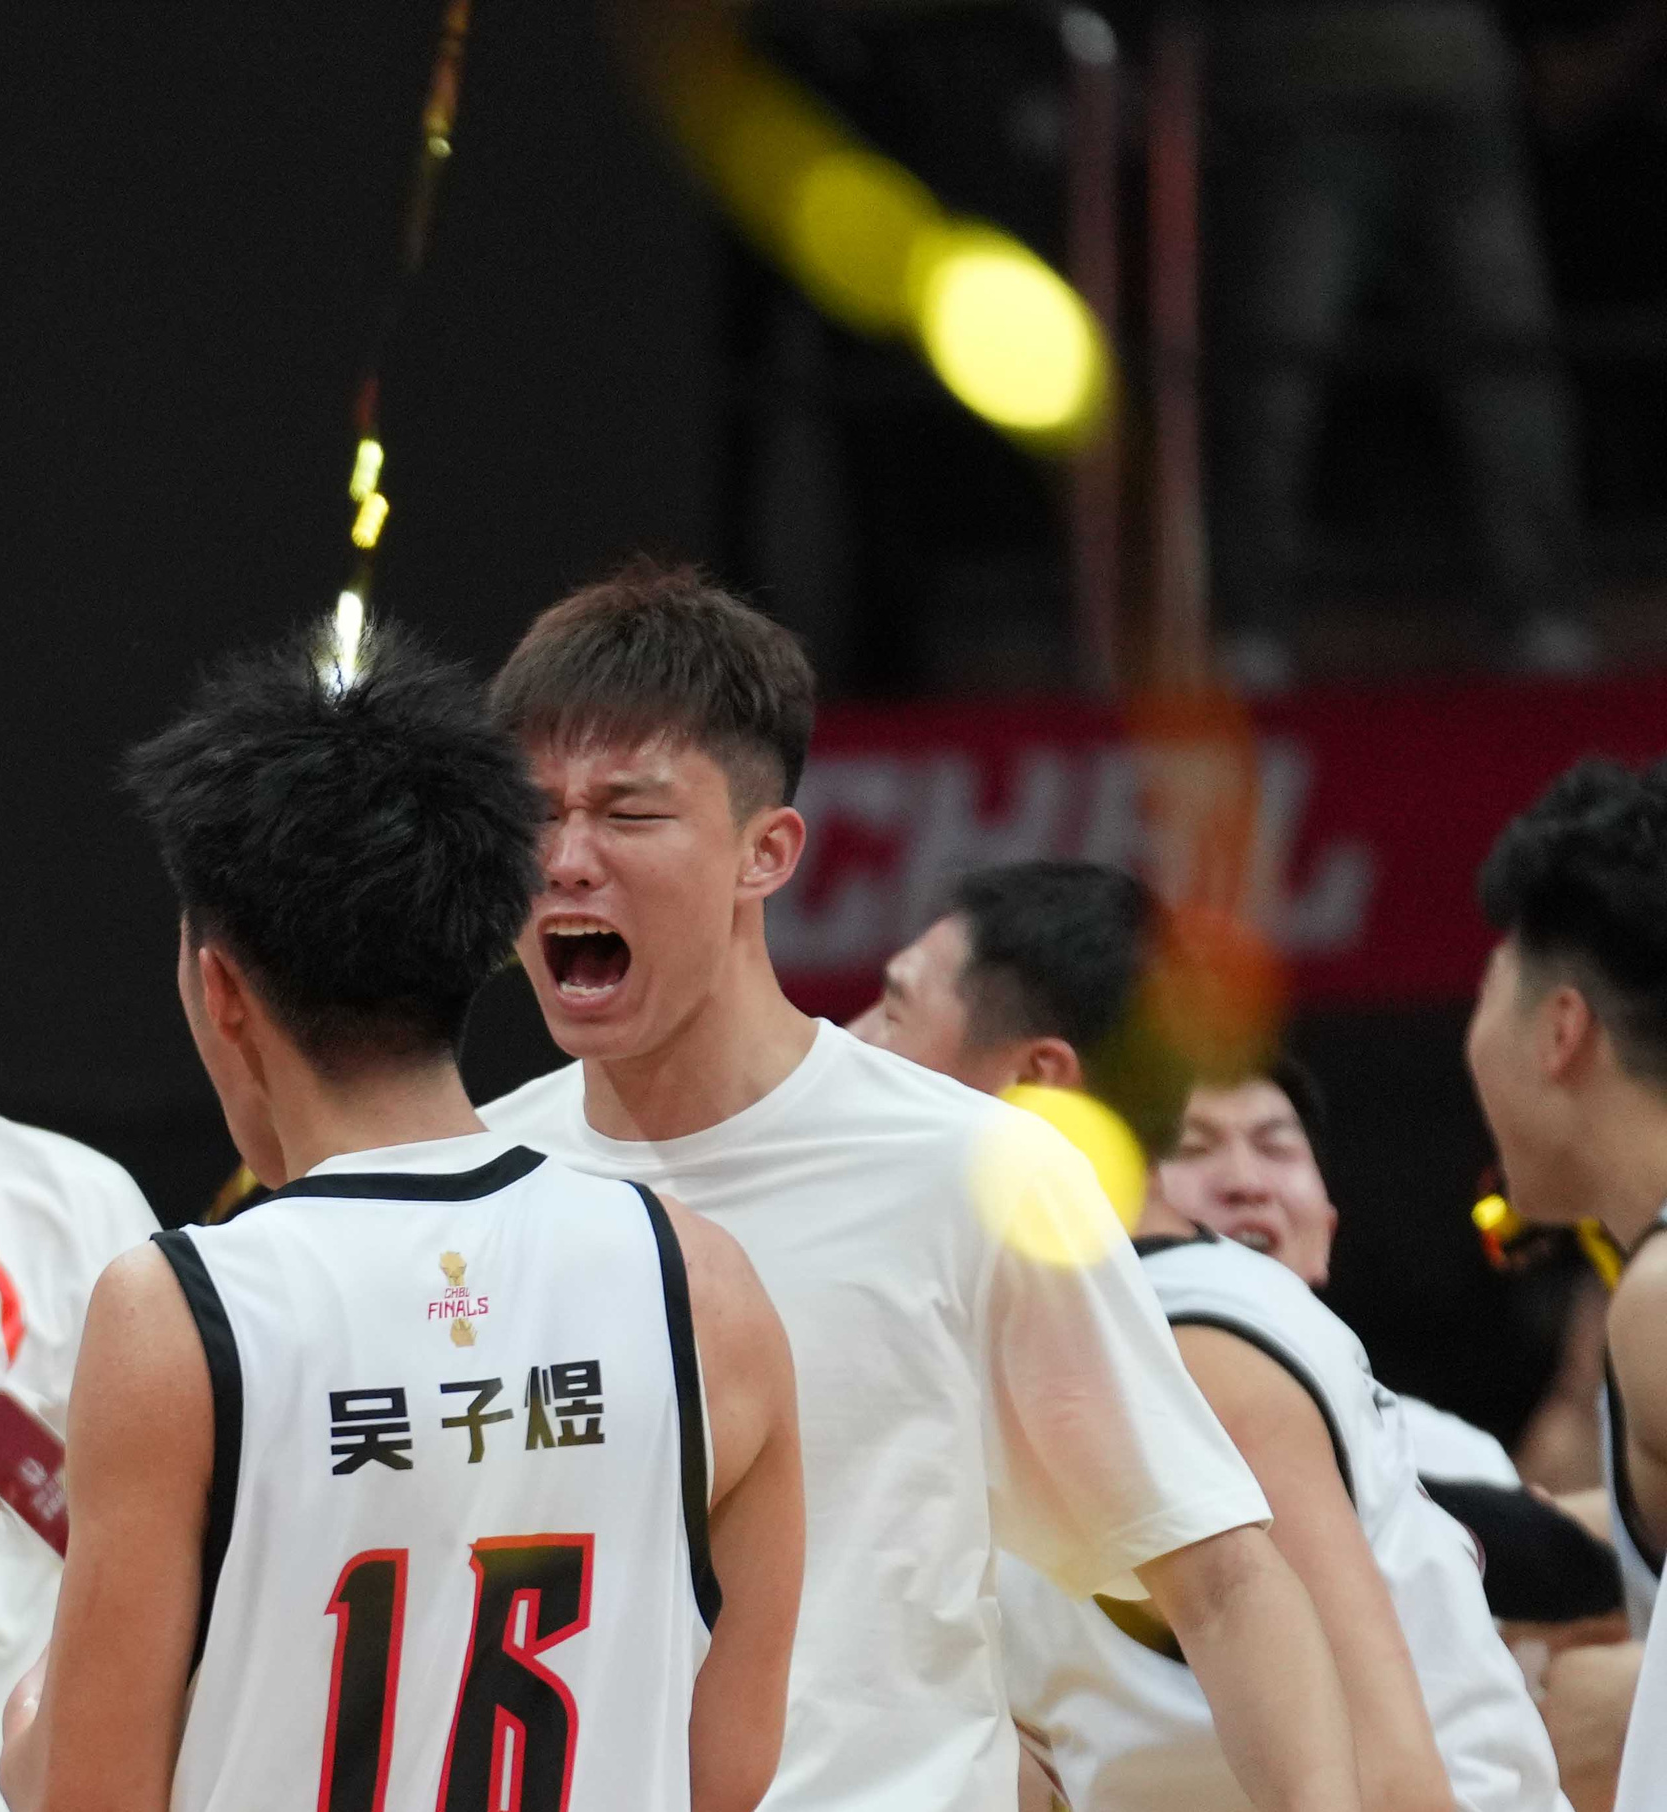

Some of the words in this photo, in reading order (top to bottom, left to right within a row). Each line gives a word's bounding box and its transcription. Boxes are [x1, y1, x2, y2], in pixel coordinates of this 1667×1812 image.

[444, 1286, 470, 1299] CHBL
[427, 1296, 489, 1321] FINALS
[328, 1359, 606, 1476] 吴子煜
